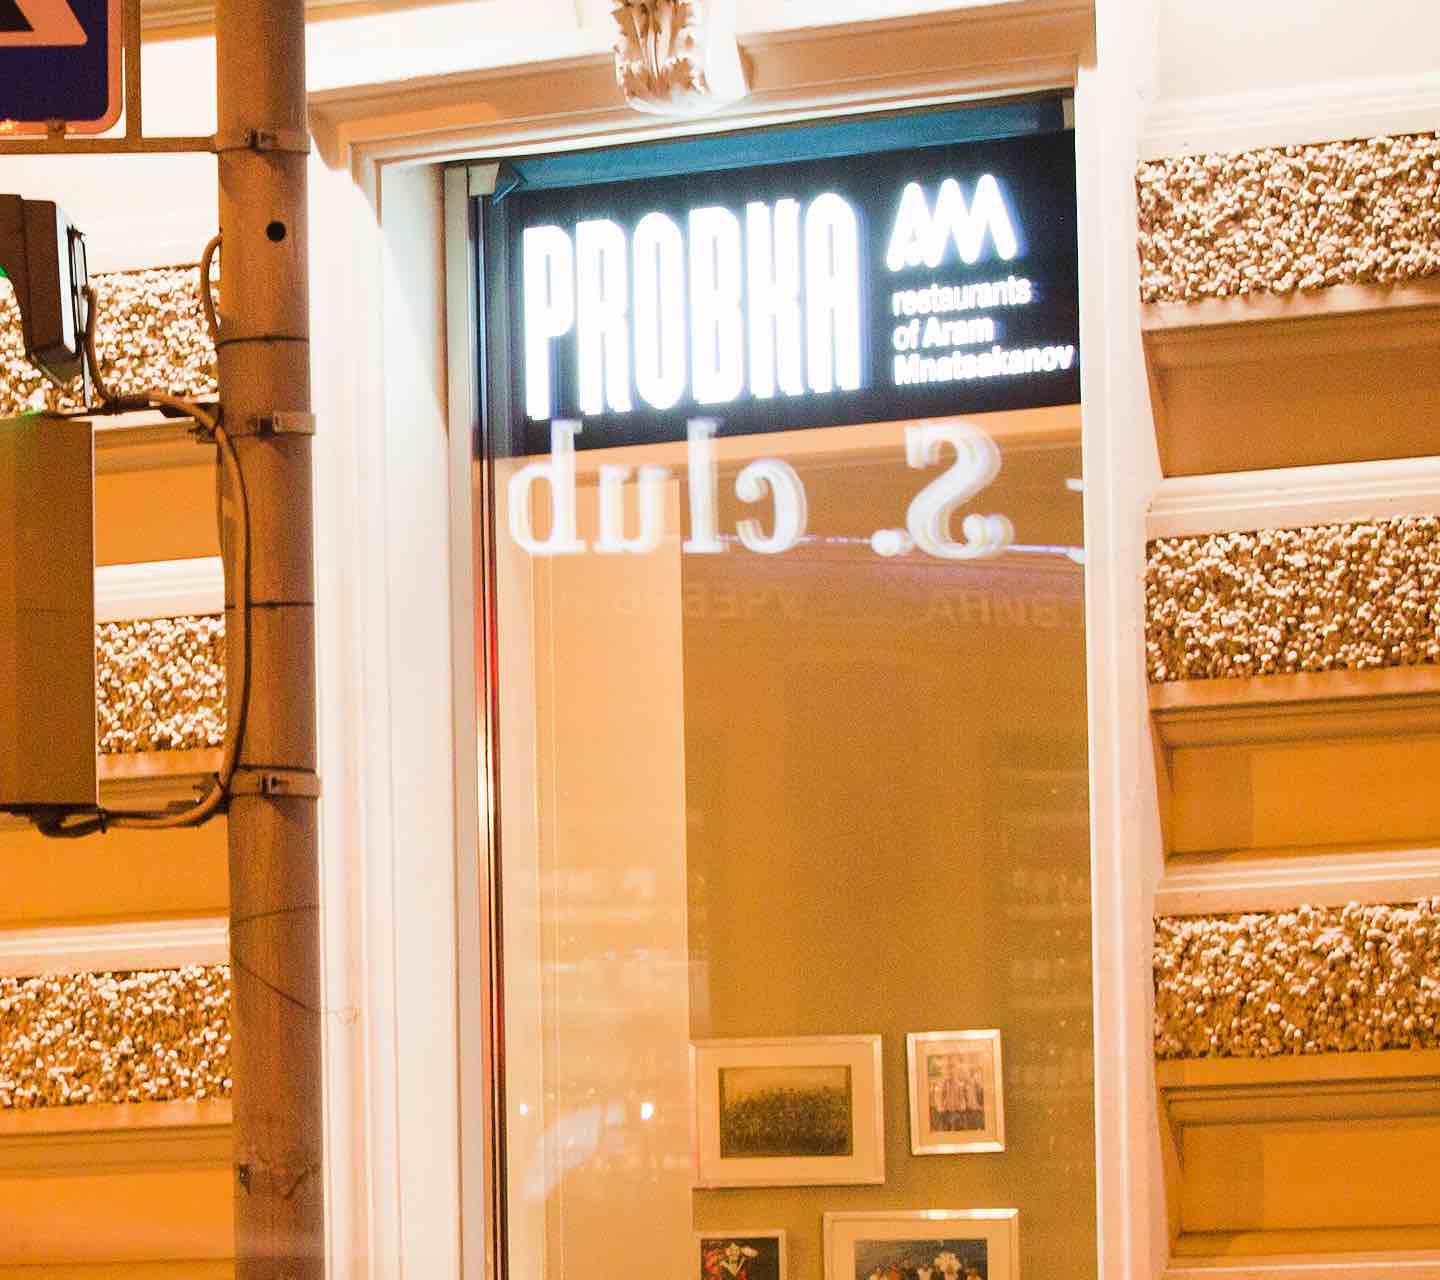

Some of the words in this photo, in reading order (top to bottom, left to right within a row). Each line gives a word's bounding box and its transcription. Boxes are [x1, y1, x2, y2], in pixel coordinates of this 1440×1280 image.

[522, 192, 862, 421] PROBKA
[892, 276, 1033, 317] restaurants
[893, 318, 921, 351] of
[923, 316, 995, 348] Aram
